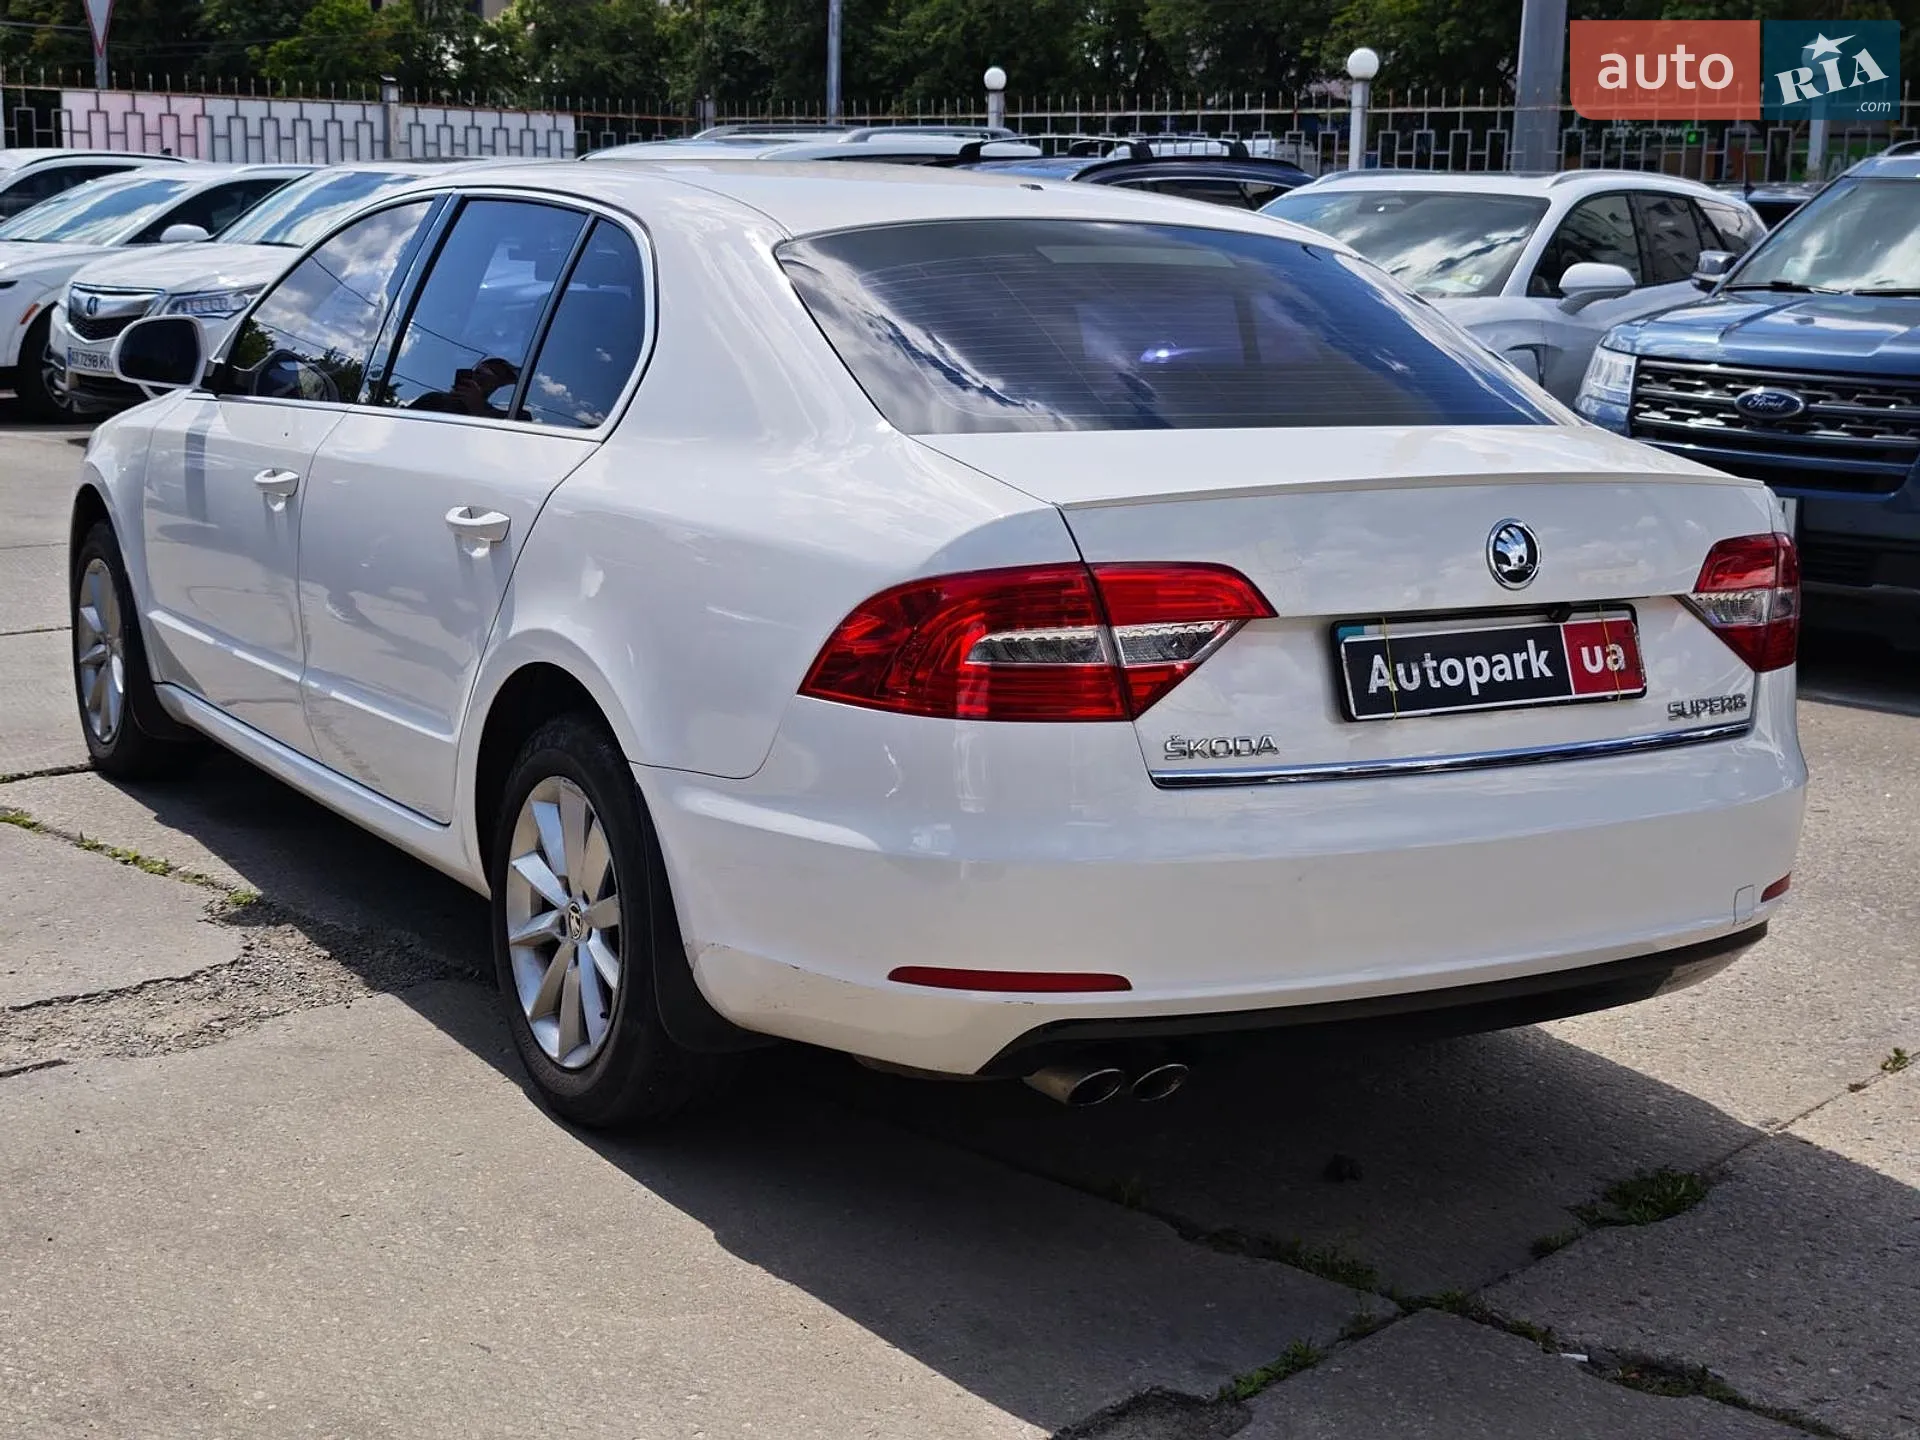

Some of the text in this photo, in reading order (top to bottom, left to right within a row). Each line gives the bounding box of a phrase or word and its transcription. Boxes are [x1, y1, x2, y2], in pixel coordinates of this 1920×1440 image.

[1747, 394, 1787, 409] Ford
[1367, 639, 1625, 696] Autopark ua
[1667, 693, 1747, 721] SUPERB
[1164, 734, 1280, 761] ŠKODA
